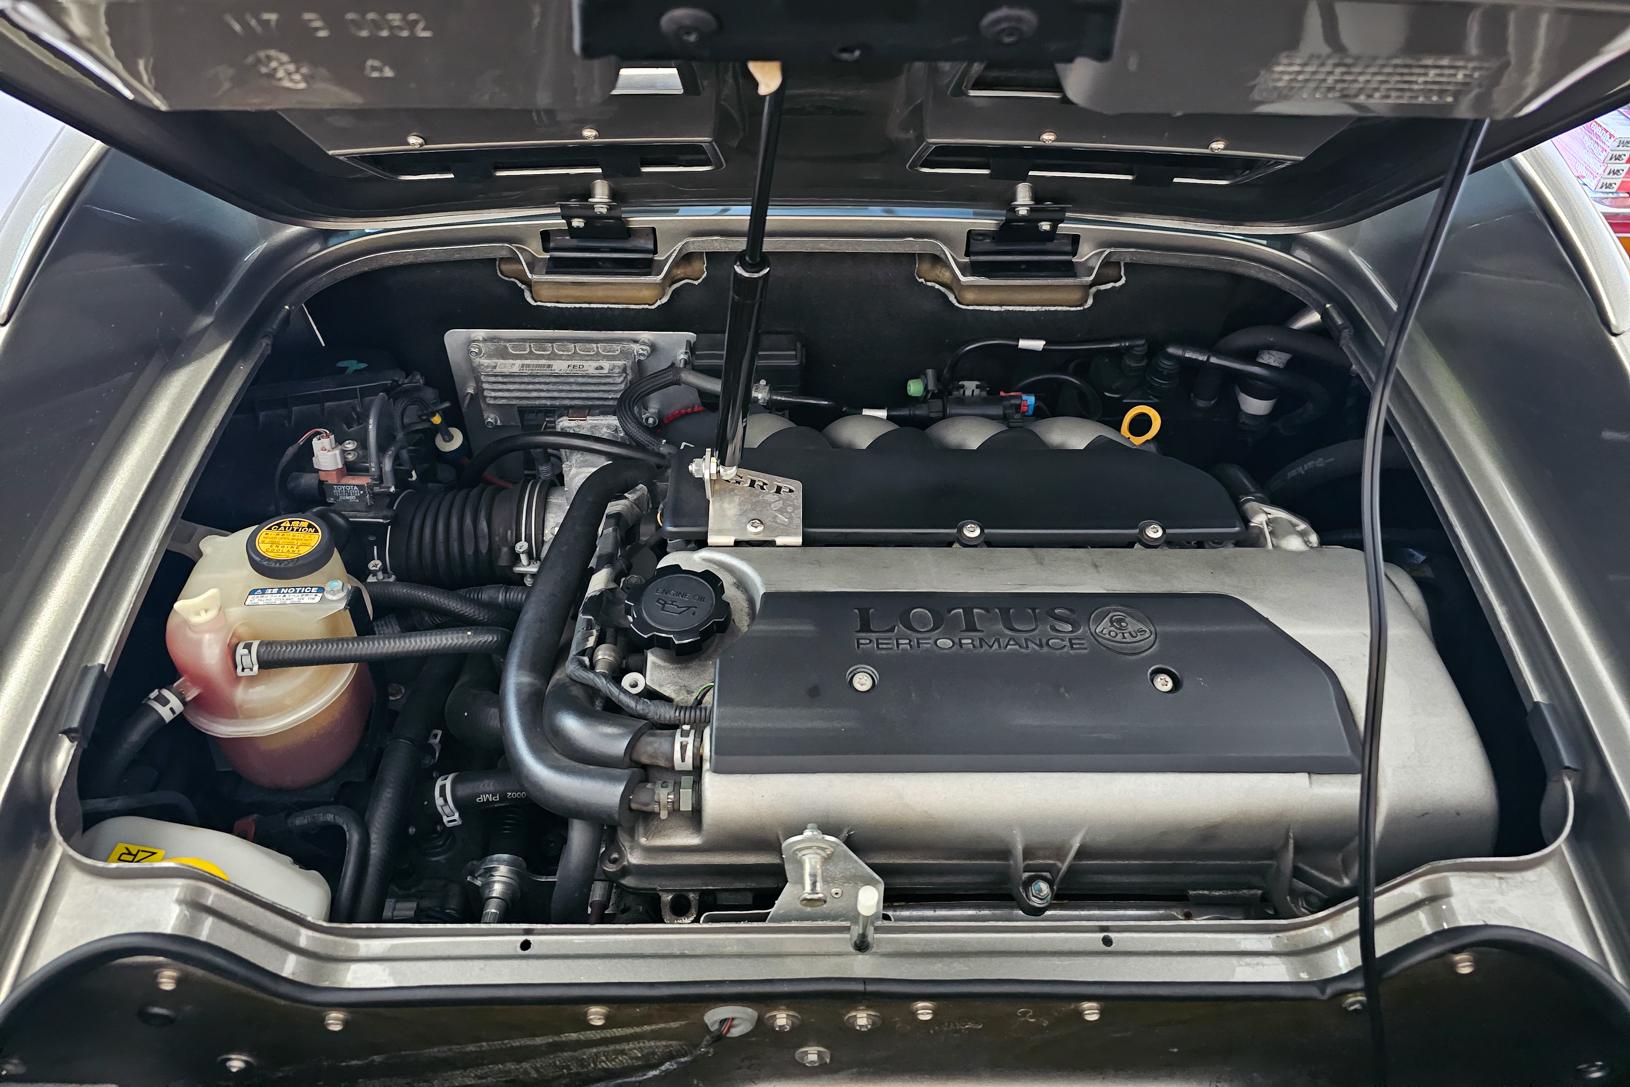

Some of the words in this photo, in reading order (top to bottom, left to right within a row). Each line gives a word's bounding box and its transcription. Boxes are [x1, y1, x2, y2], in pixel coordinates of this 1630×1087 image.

[1609, 153, 1626, 162] 3M
[1607, 168, 1624, 176] 3M
[1599, 181, 1617, 190] 3M
[656, 588, 691, 600] ENGINE
[854, 606, 1083, 633] LOTUS
[1099, 626, 1148, 640] LOTUS
[856, 636, 1088, 651] PERFORMANCE
[476, 793, 500, 803] PMP
